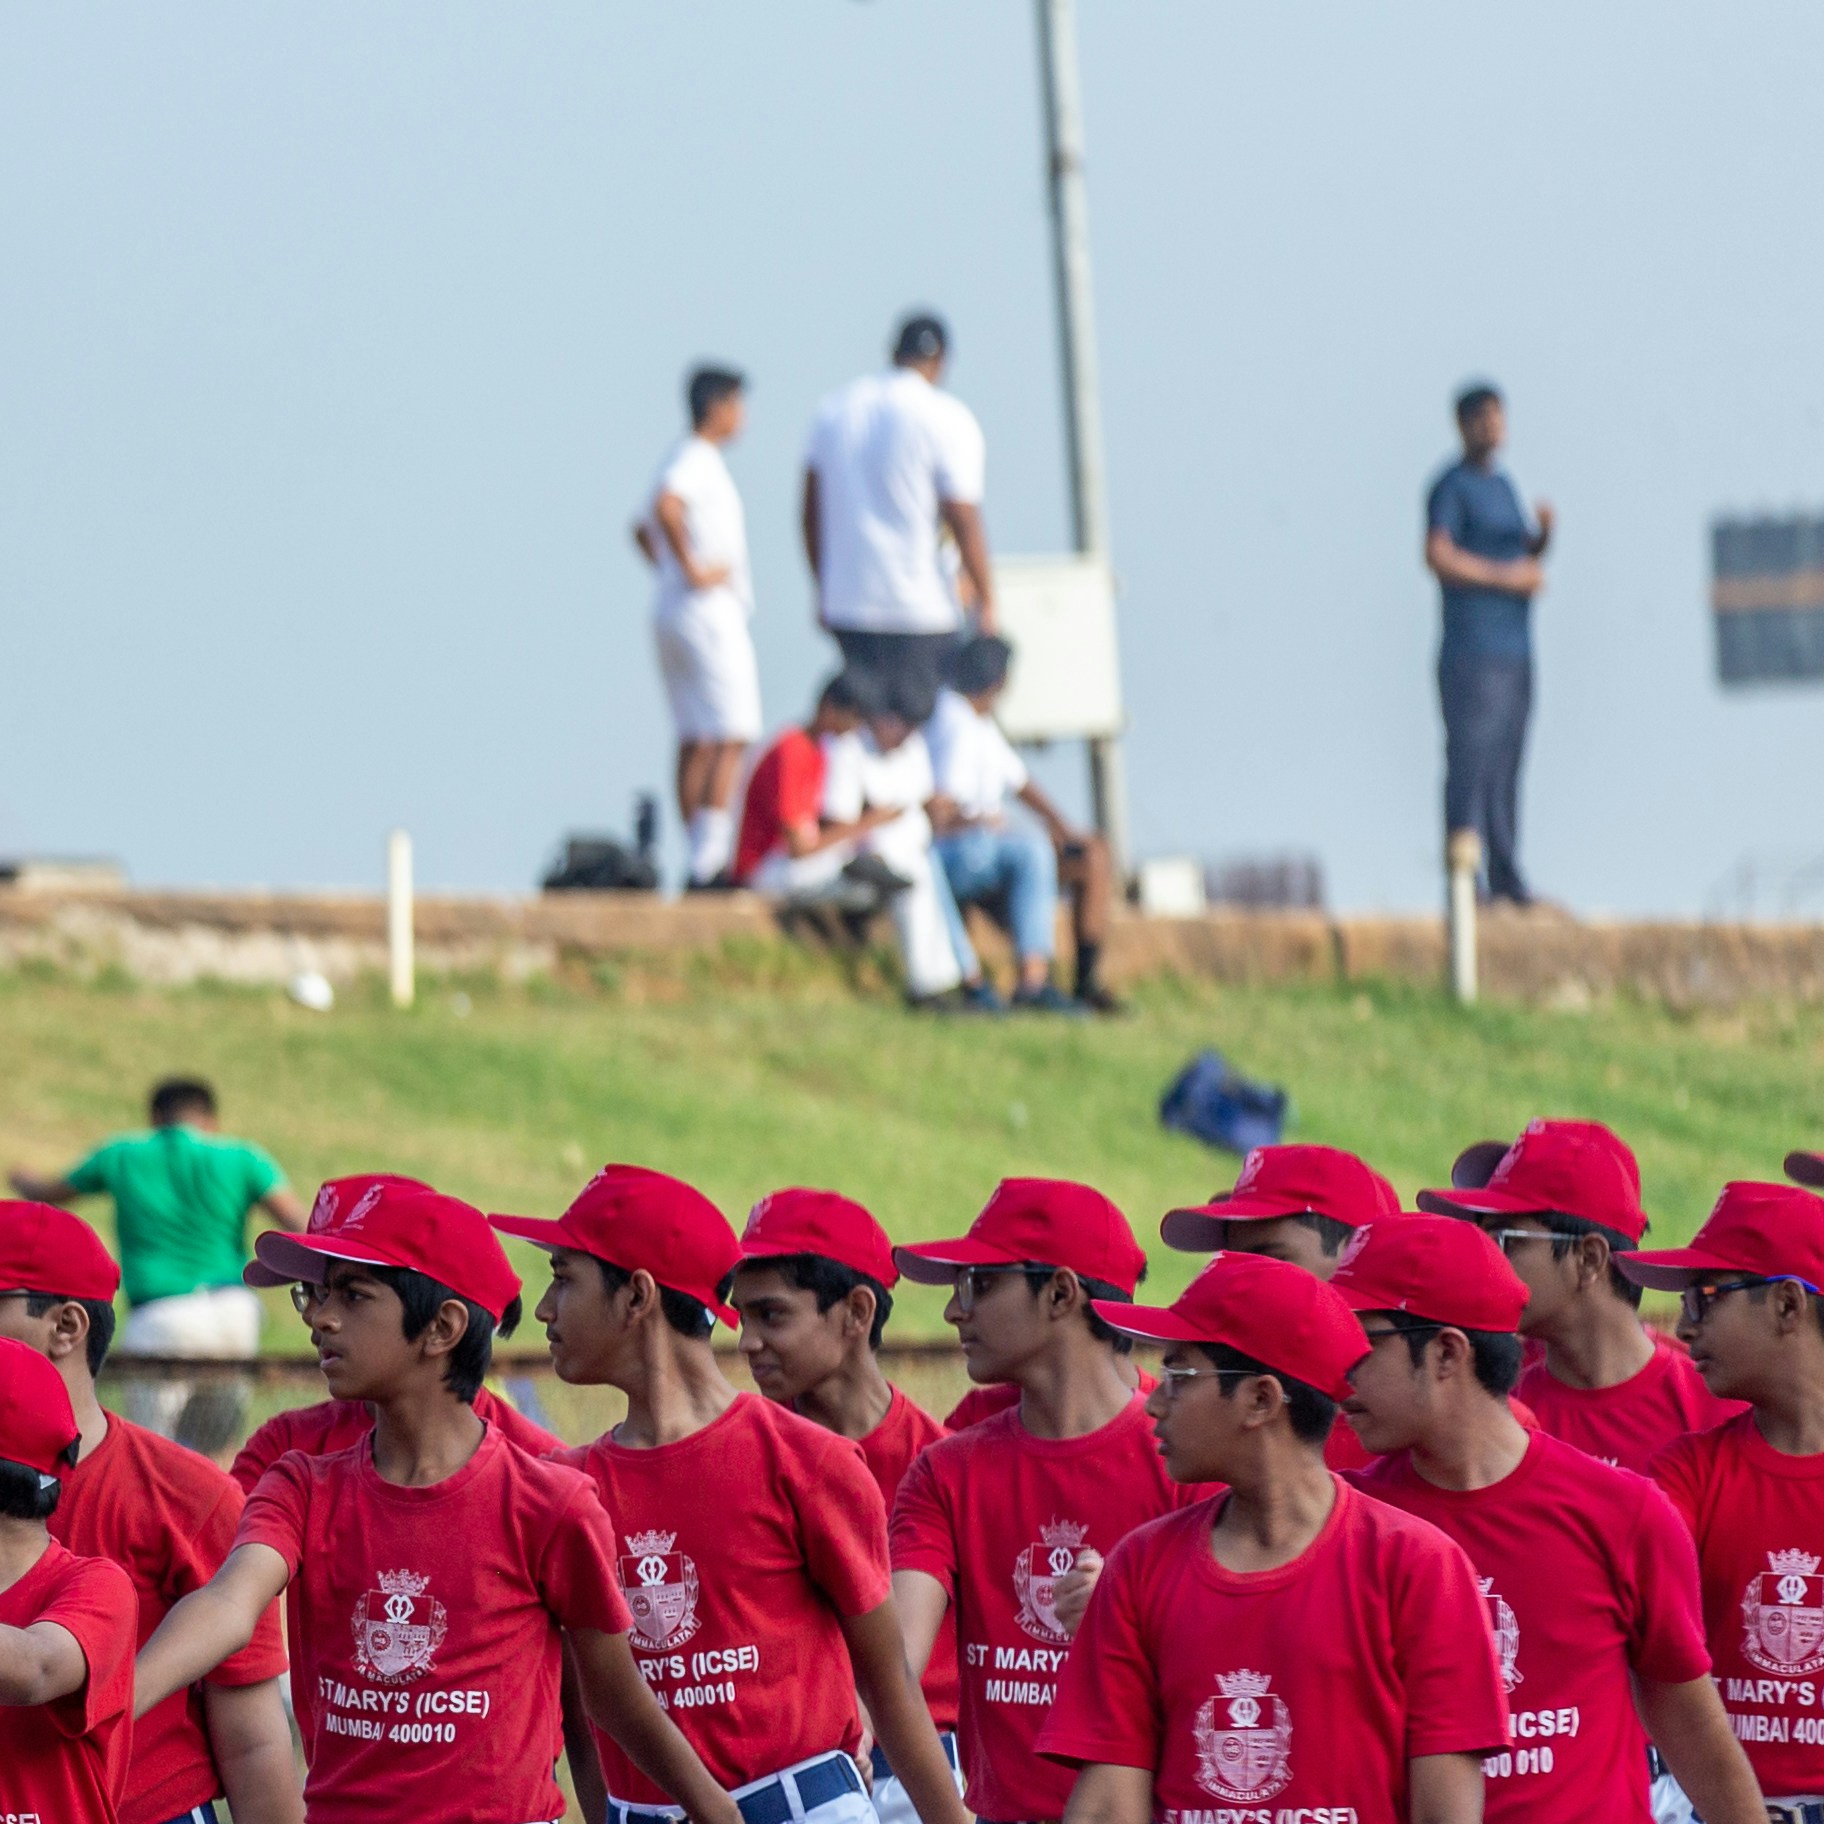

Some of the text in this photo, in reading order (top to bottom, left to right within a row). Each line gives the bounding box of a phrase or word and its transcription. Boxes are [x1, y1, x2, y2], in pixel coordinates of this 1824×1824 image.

[630, 1629, 692, 1650] IMMACULATA
[639, 1645, 759, 1683] RY'S (ICSE)
[967, 1642, 1069, 1673] ST MARY'
[333, 1683, 410, 1714] MARY'S
[415, 1690, 490, 1719] (ICSE)
[1727, 1677, 1816, 1706] MARY'S
[388, 1723, 456, 1743] 400010
[1508, 1706, 1580, 1738] ICSE)
[1480, 1746, 1554, 1778] 00 010
